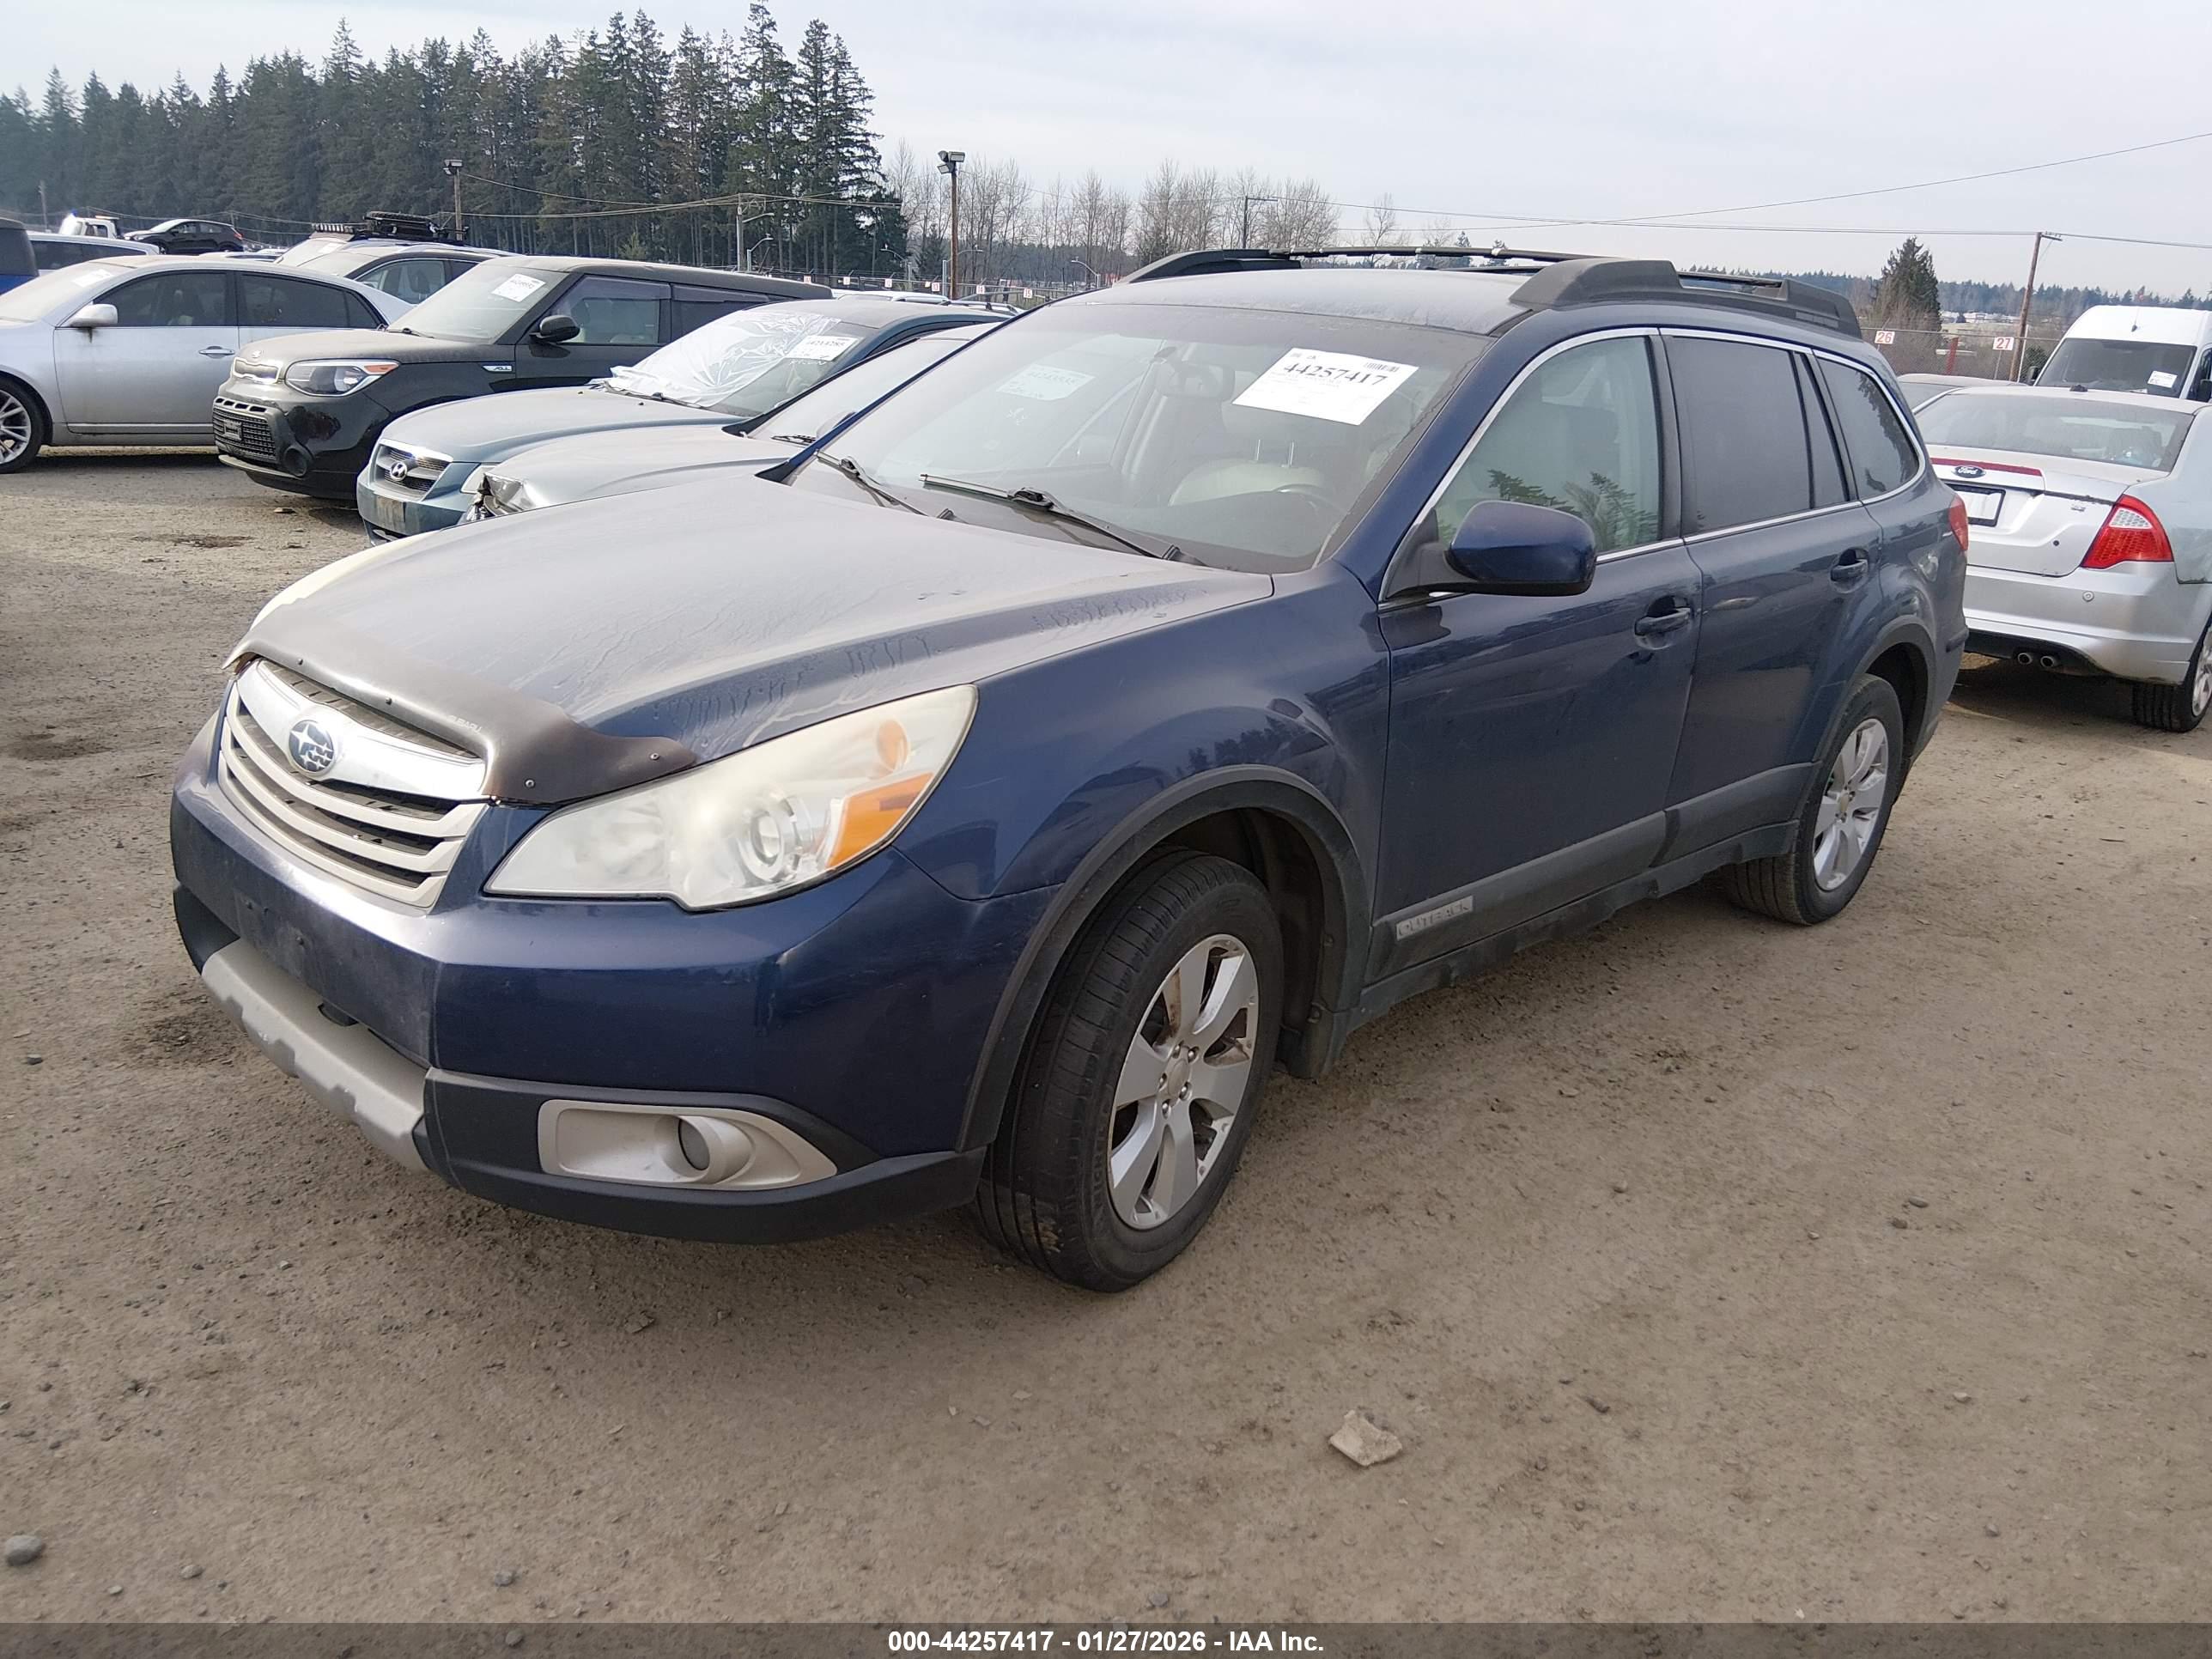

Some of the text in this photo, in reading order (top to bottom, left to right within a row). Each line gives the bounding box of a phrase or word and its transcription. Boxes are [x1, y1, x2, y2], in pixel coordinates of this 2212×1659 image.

[1877, 331, 1893, 343] 26
[1996, 337, 2011, 349] 27
[1283, 362, 1389, 386] 44257417
[1957, 465, 1979, 476] Ford
[1398, 902, 1469, 936] OUTBACK
